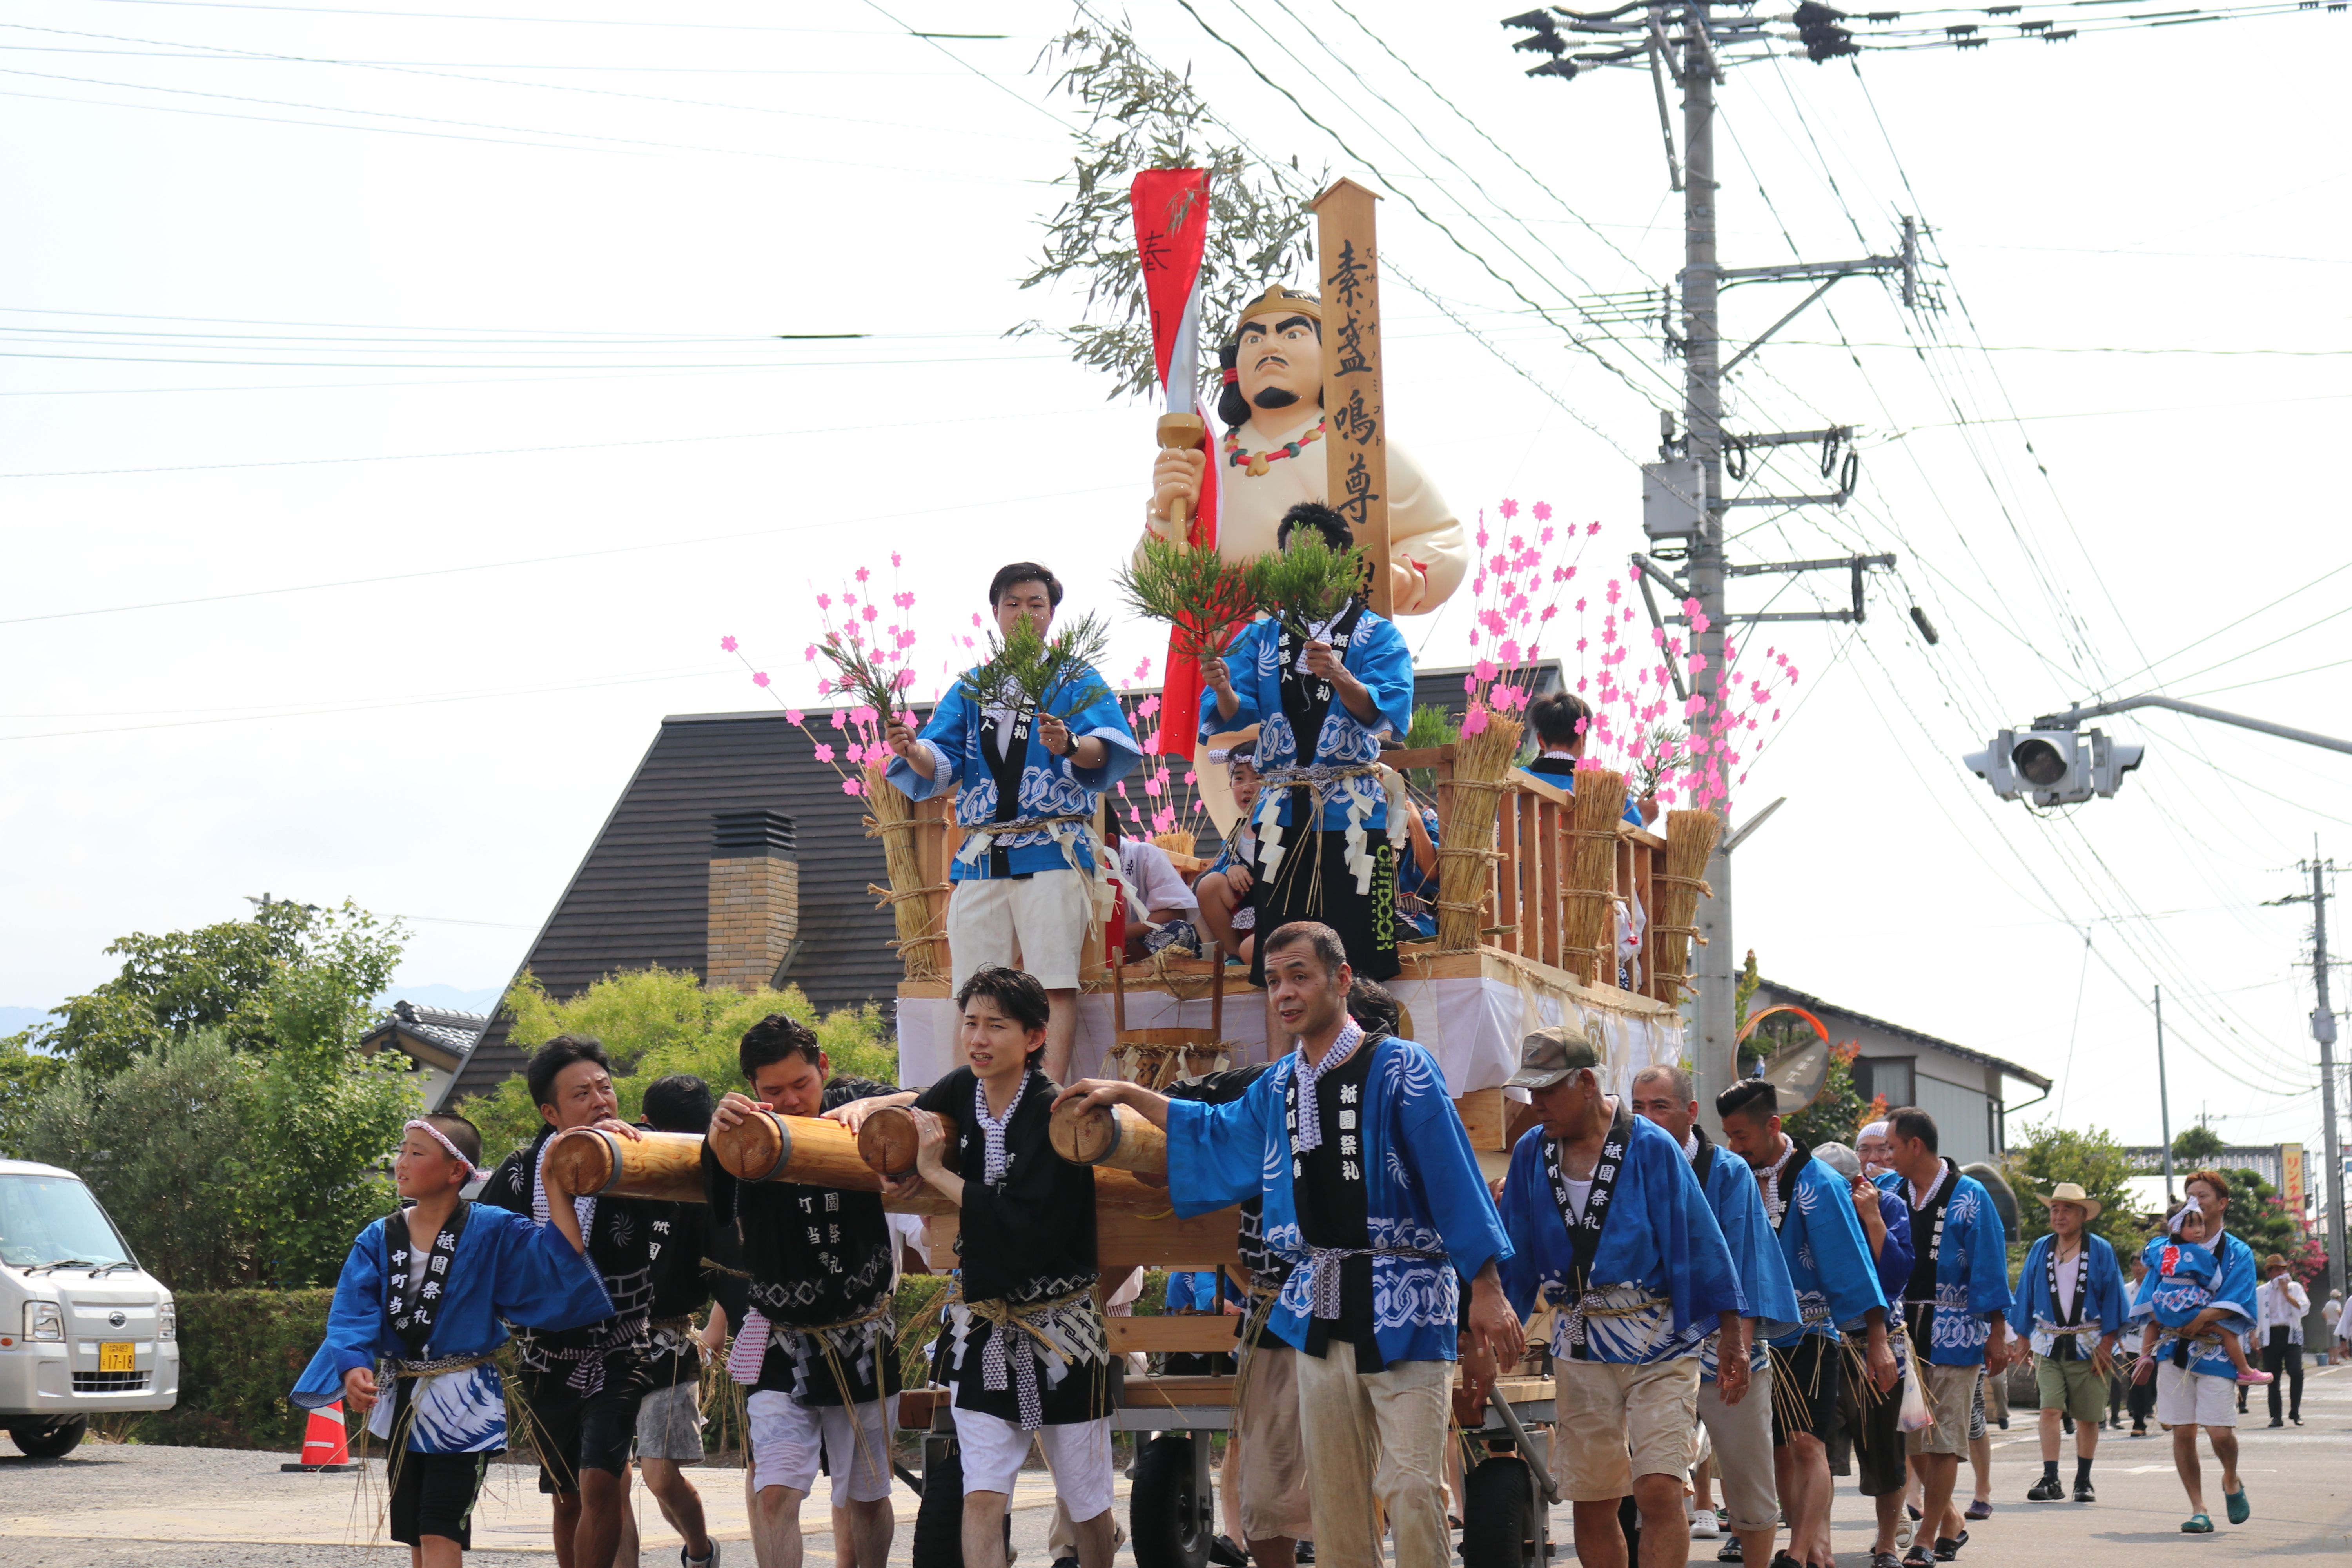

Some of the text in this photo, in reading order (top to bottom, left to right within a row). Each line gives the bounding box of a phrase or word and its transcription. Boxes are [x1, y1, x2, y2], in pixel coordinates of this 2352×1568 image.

[1278, 633, 1293, 683] 世話人
[1316, 632, 1349, 701] 祇園礼
[1340, 1084, 1360, 1180] 祇園祭礼
[1544, 1143, 1575, 1227] 中町当番
[108, 1355, 132, 1369] 17-18
